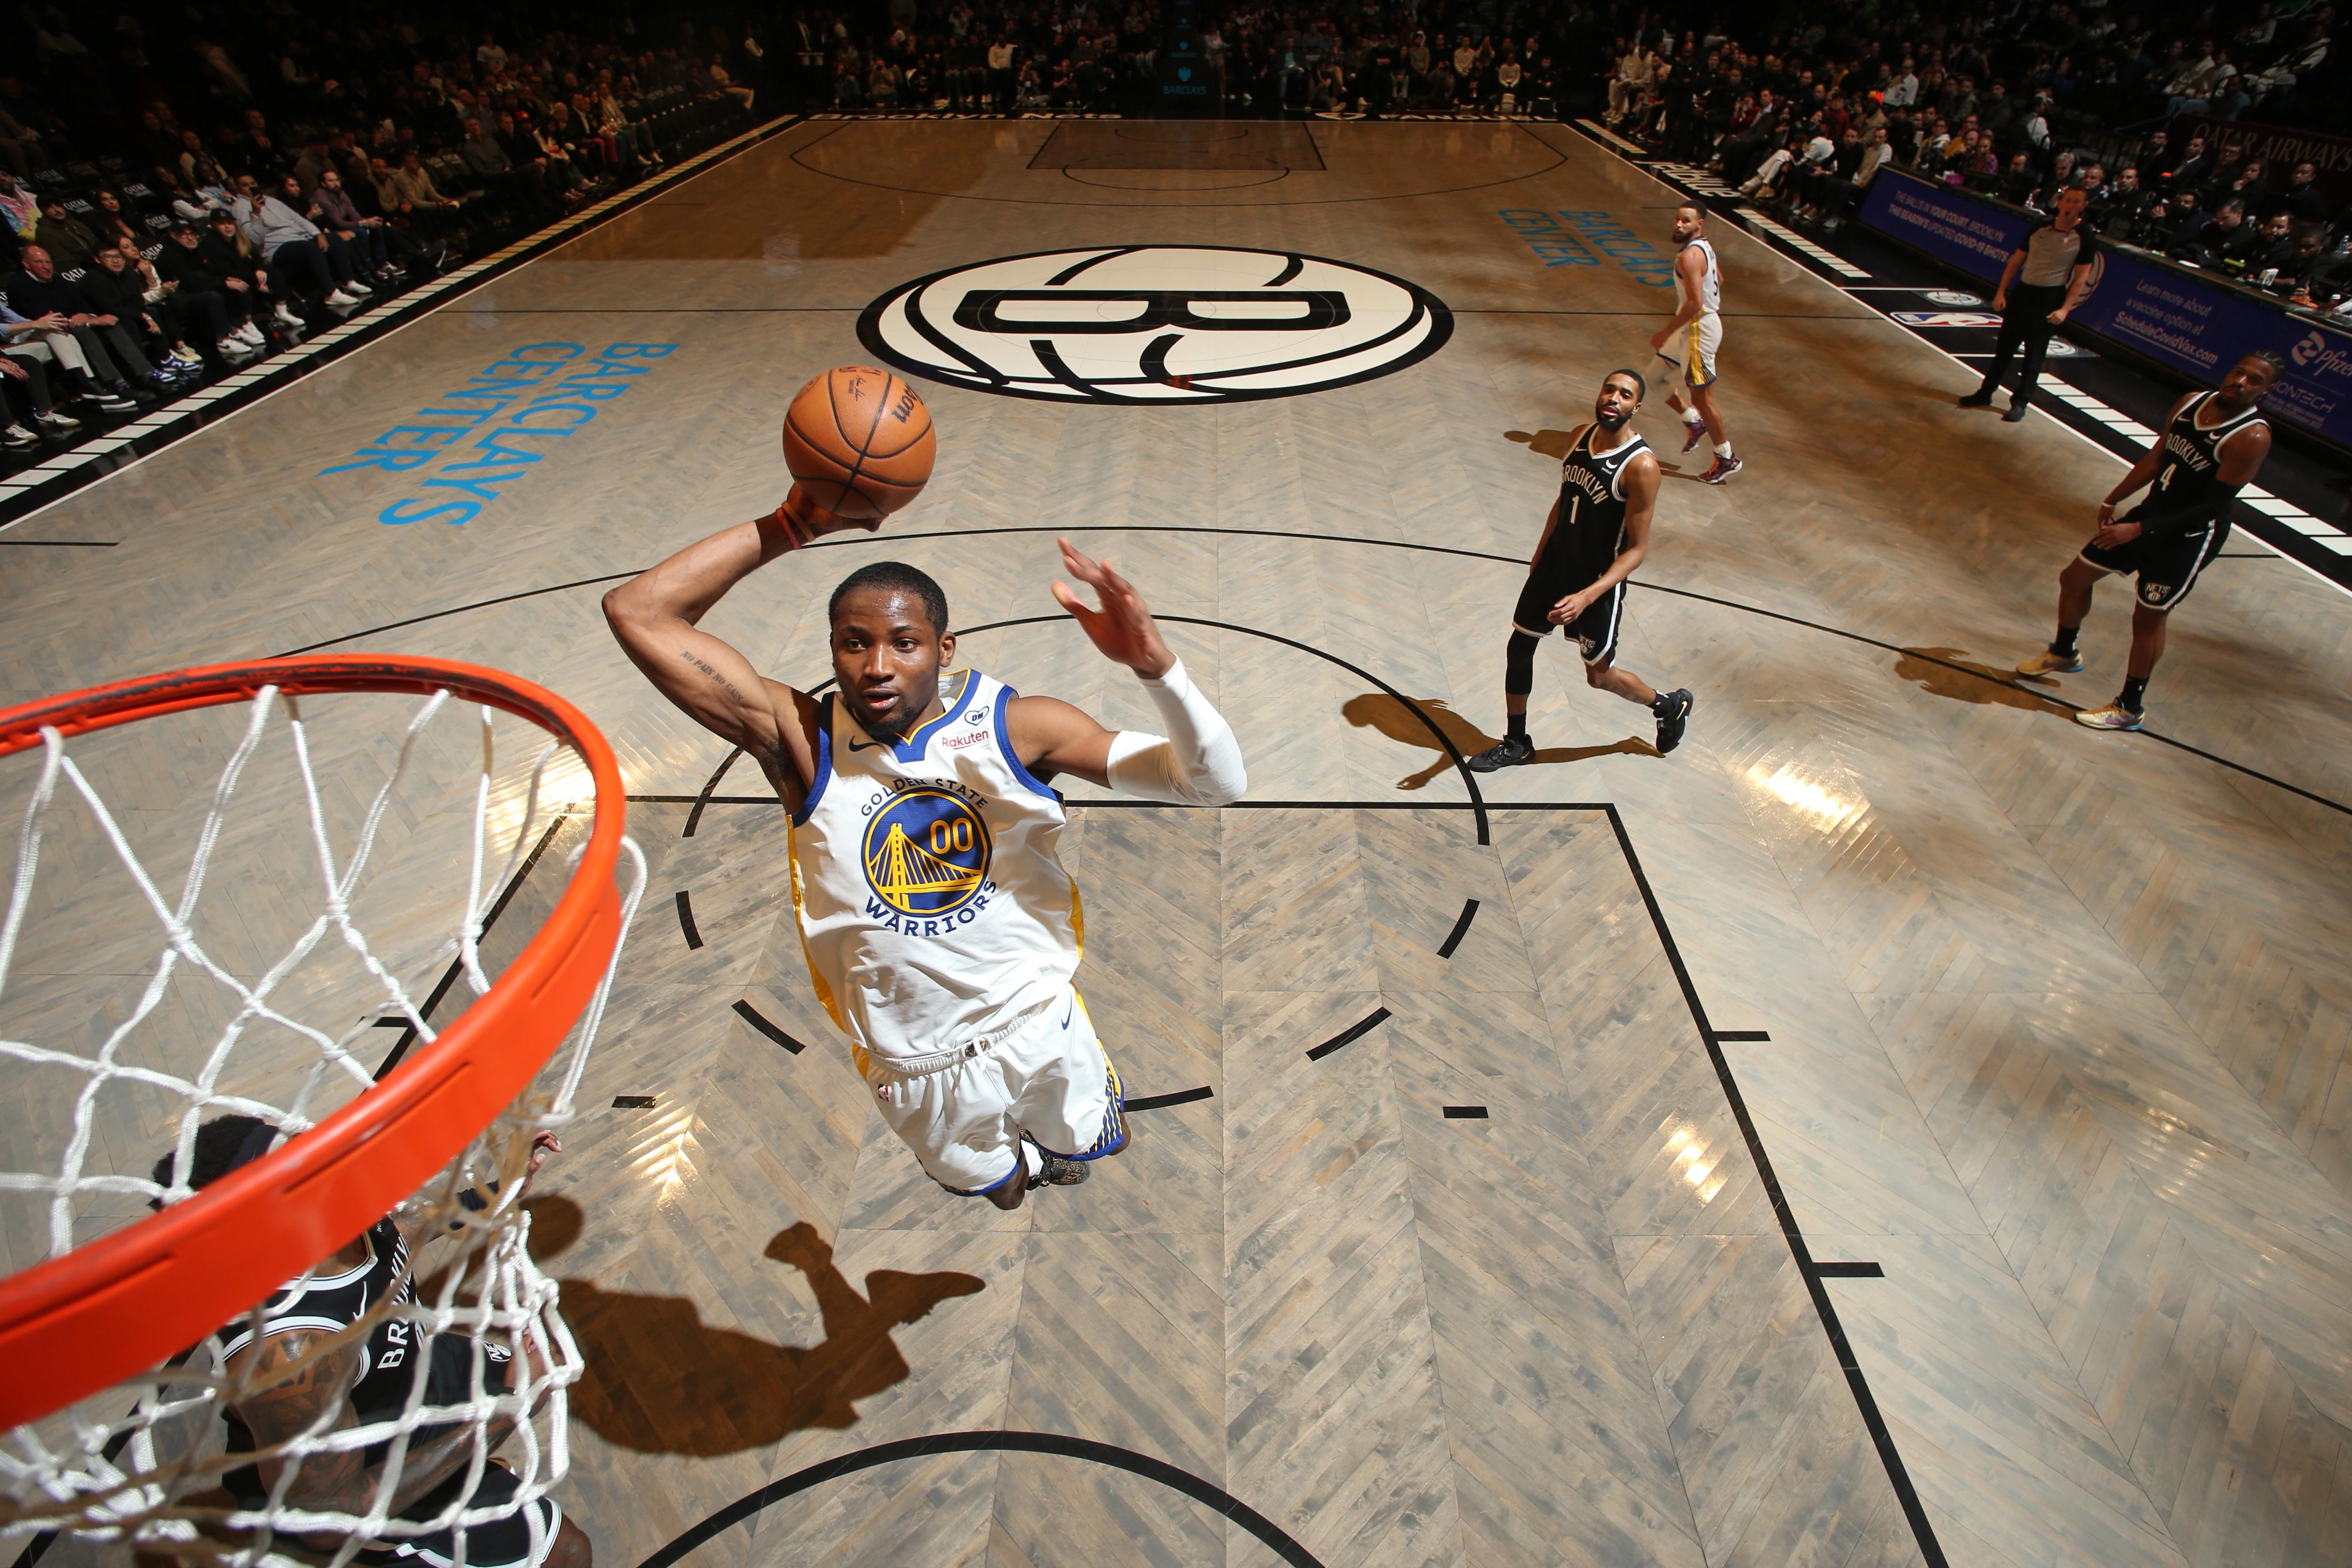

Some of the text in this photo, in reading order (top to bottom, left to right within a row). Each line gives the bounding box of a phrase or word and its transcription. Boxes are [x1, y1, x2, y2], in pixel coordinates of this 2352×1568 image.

[1162, 86, 1208, 95] BARCLAYS
[2193, 122, 2352, 172] QATR AIRWAYS
[63, 199, 89, 211] QATAR
[1930, 205, 1947, 219] YOUR
[1968, 221, 2005, 242] BROOKLYN
[1498, 209, 1601, 267] CENTER
[1954, 232, 1986, 252] COVID-19
[1983, 245, 2009, 262] SHOTS
[61, 267, 87, 282] QATA
[2136, 278, 2212, 317] Learn more about
[2125, 297, 2205, 336] a vaccine option at
[2115, 310, 2218, 365] ScheduleCovidVax.com
[315, 342, 585, 477] CENTER
[2273, 380, 2336, 413] IONTECH
[378, 343, 680, 525] BARCLAYS
[2165, 433, 2211, 472] ROOKLYN
[2160, 462, 2177, 492] 4
[1570, 495, 1579, 524] 1
[680, 651, 743, 701] NO PAIN NO GAIN
[972, 712, 984, 721] DM
[942, 731, 988, 747] Rakuten
[861, 778, 988, 816] GOLDEN STATE
[930, 817, 974, 854] 00
[866, 881, 997, 936] WARRIORS
